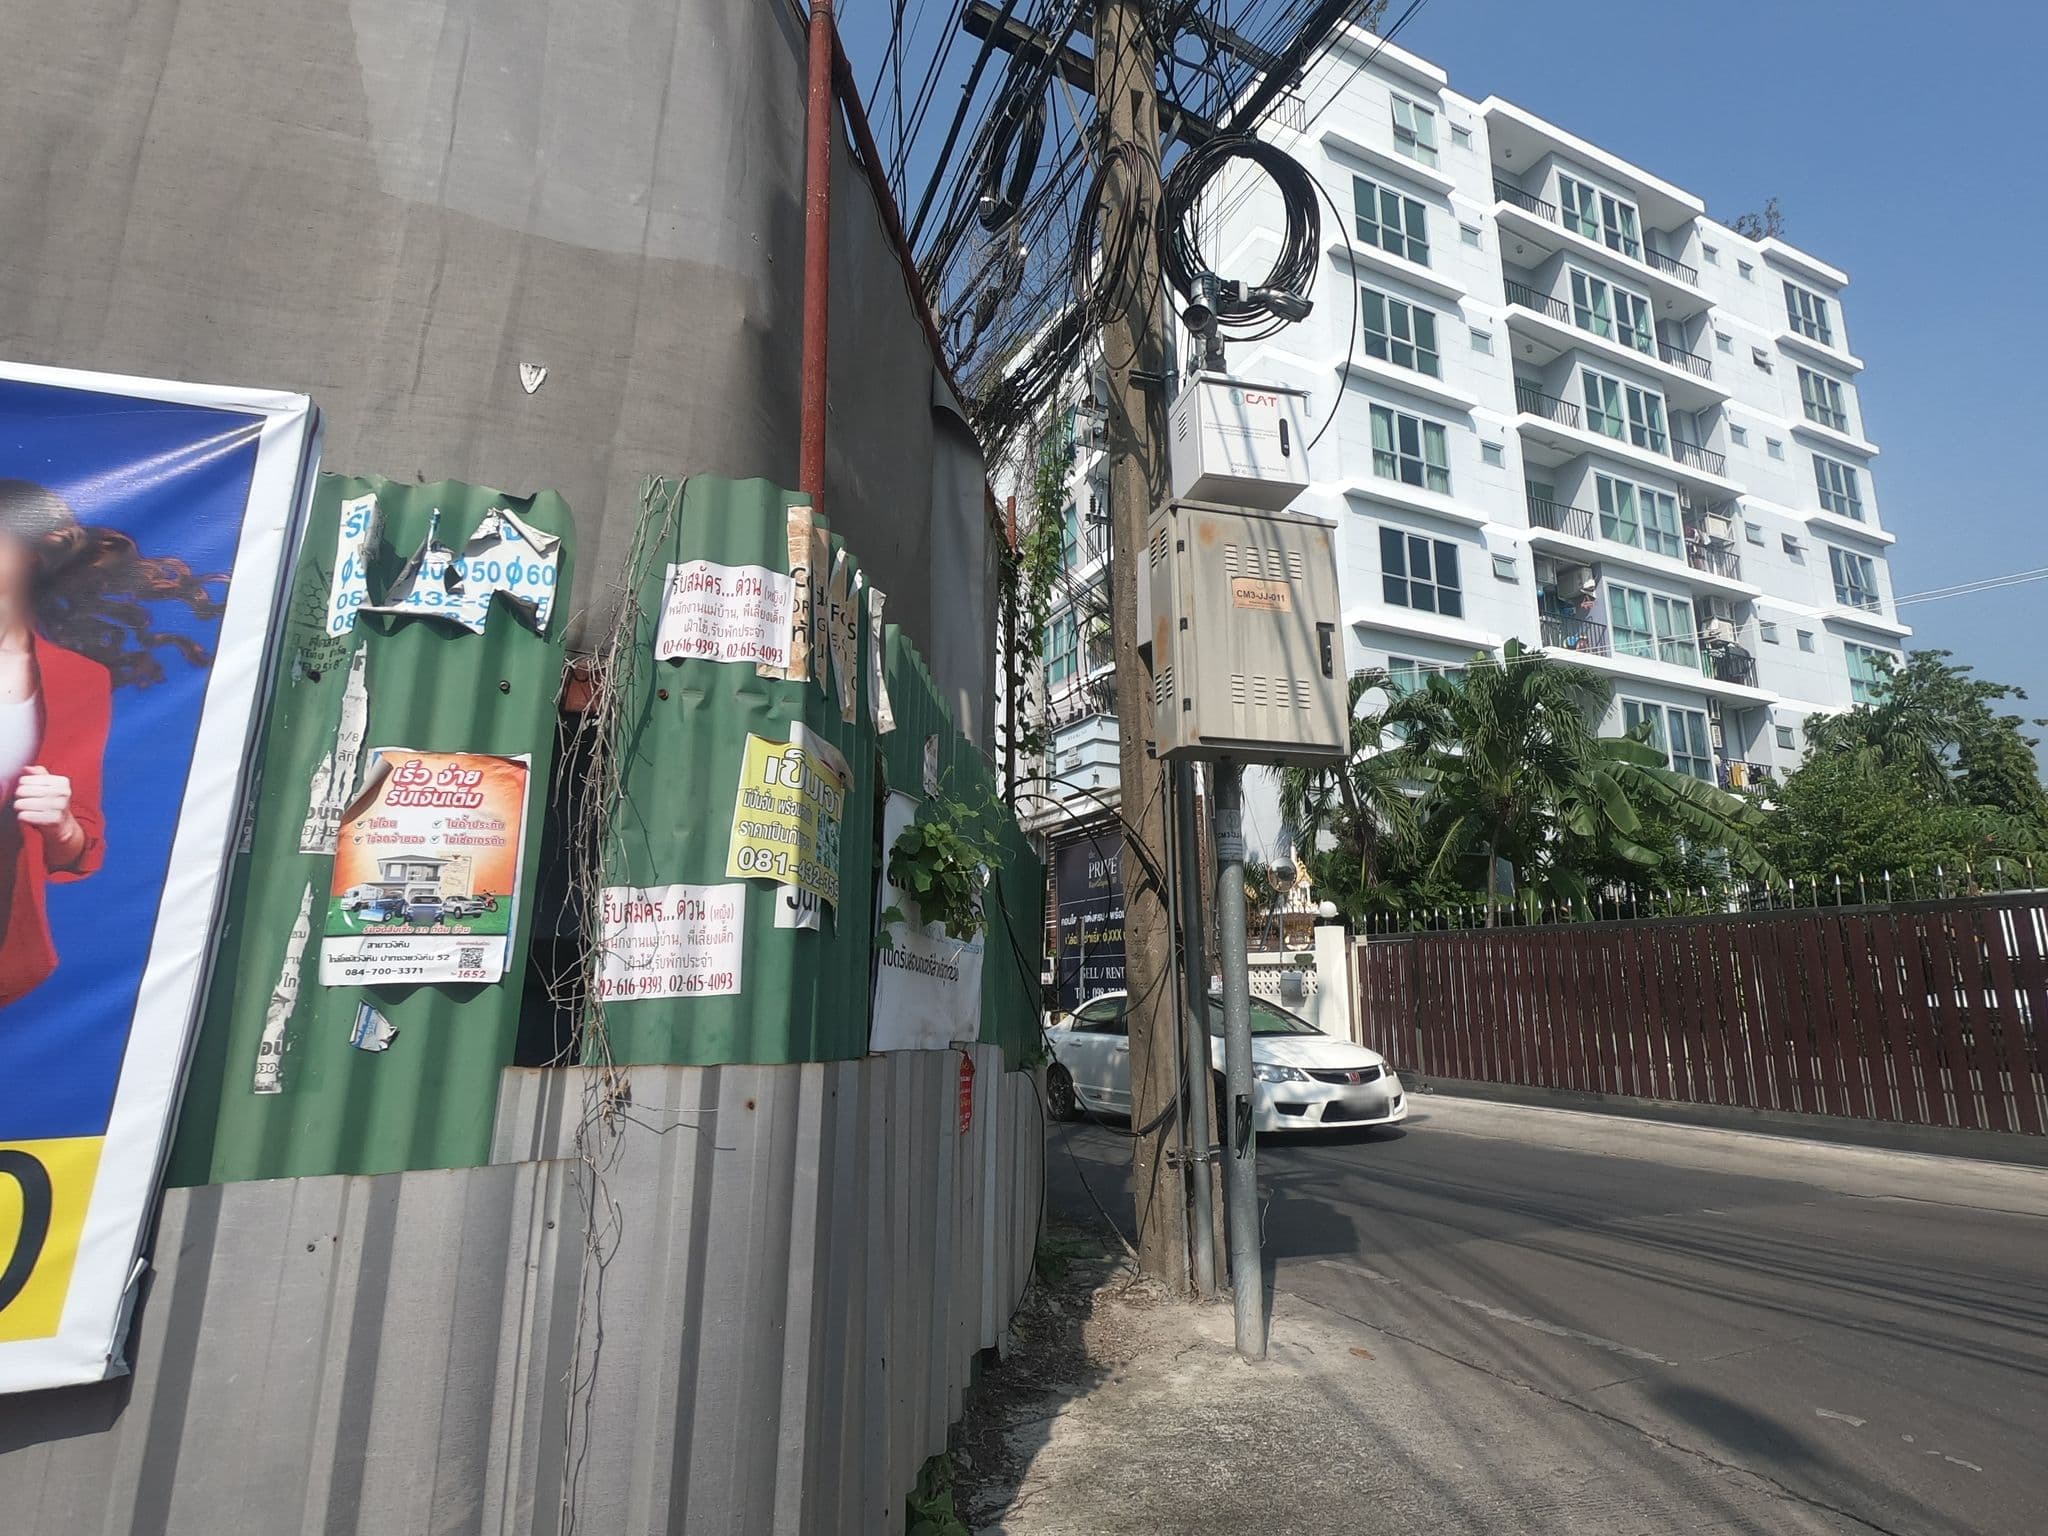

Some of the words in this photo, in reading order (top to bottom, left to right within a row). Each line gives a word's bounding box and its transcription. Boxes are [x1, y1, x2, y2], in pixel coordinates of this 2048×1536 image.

[1245, 393, 1277, 408] CAT
[1236, 589, 1285, 602] CM3-JJ-011
[727, 641, 783, 663] 02-615-4093
[392, 759, 432, 785] เร็ว
[437, 763, 484, 787] ง่าย
[385, 785, 484, 808] รับเงินเต็ม
[738, 846, 840, 901] 081-432-359
[345, 967, 424, 976] 084-700-3371
[457, 970, 487, 978] 1652
[1105, 966, 1125, 979] RENT
[669, 972, 733, 993] 02-615-4093
